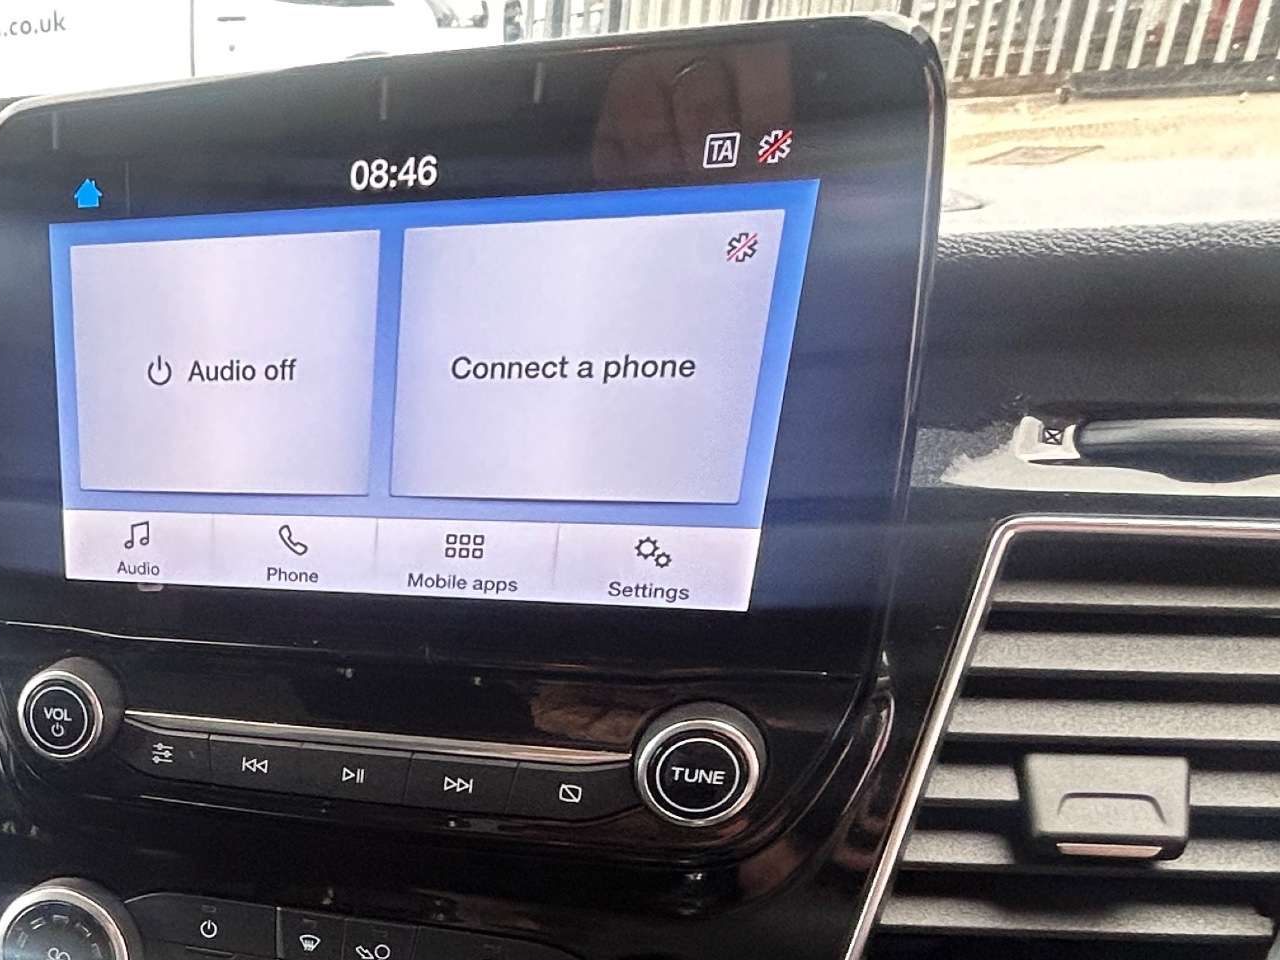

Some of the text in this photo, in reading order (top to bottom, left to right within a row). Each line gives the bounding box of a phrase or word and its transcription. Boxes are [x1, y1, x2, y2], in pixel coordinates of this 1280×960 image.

[350, 155, 439, 191] 08:46
[188, 358, 297, 382] Audio off
[451, 355, 697, 384] Connect a phone
[117, 561, 160, 576] Audio
[266, 567, 319, 583] Phone
[407, 572, 518, 594] Mobile apps
[607, 581, 690, 603] Settings
[43, 706, 73, 722] VOL
[671, 766, 726, 785] TUNE
